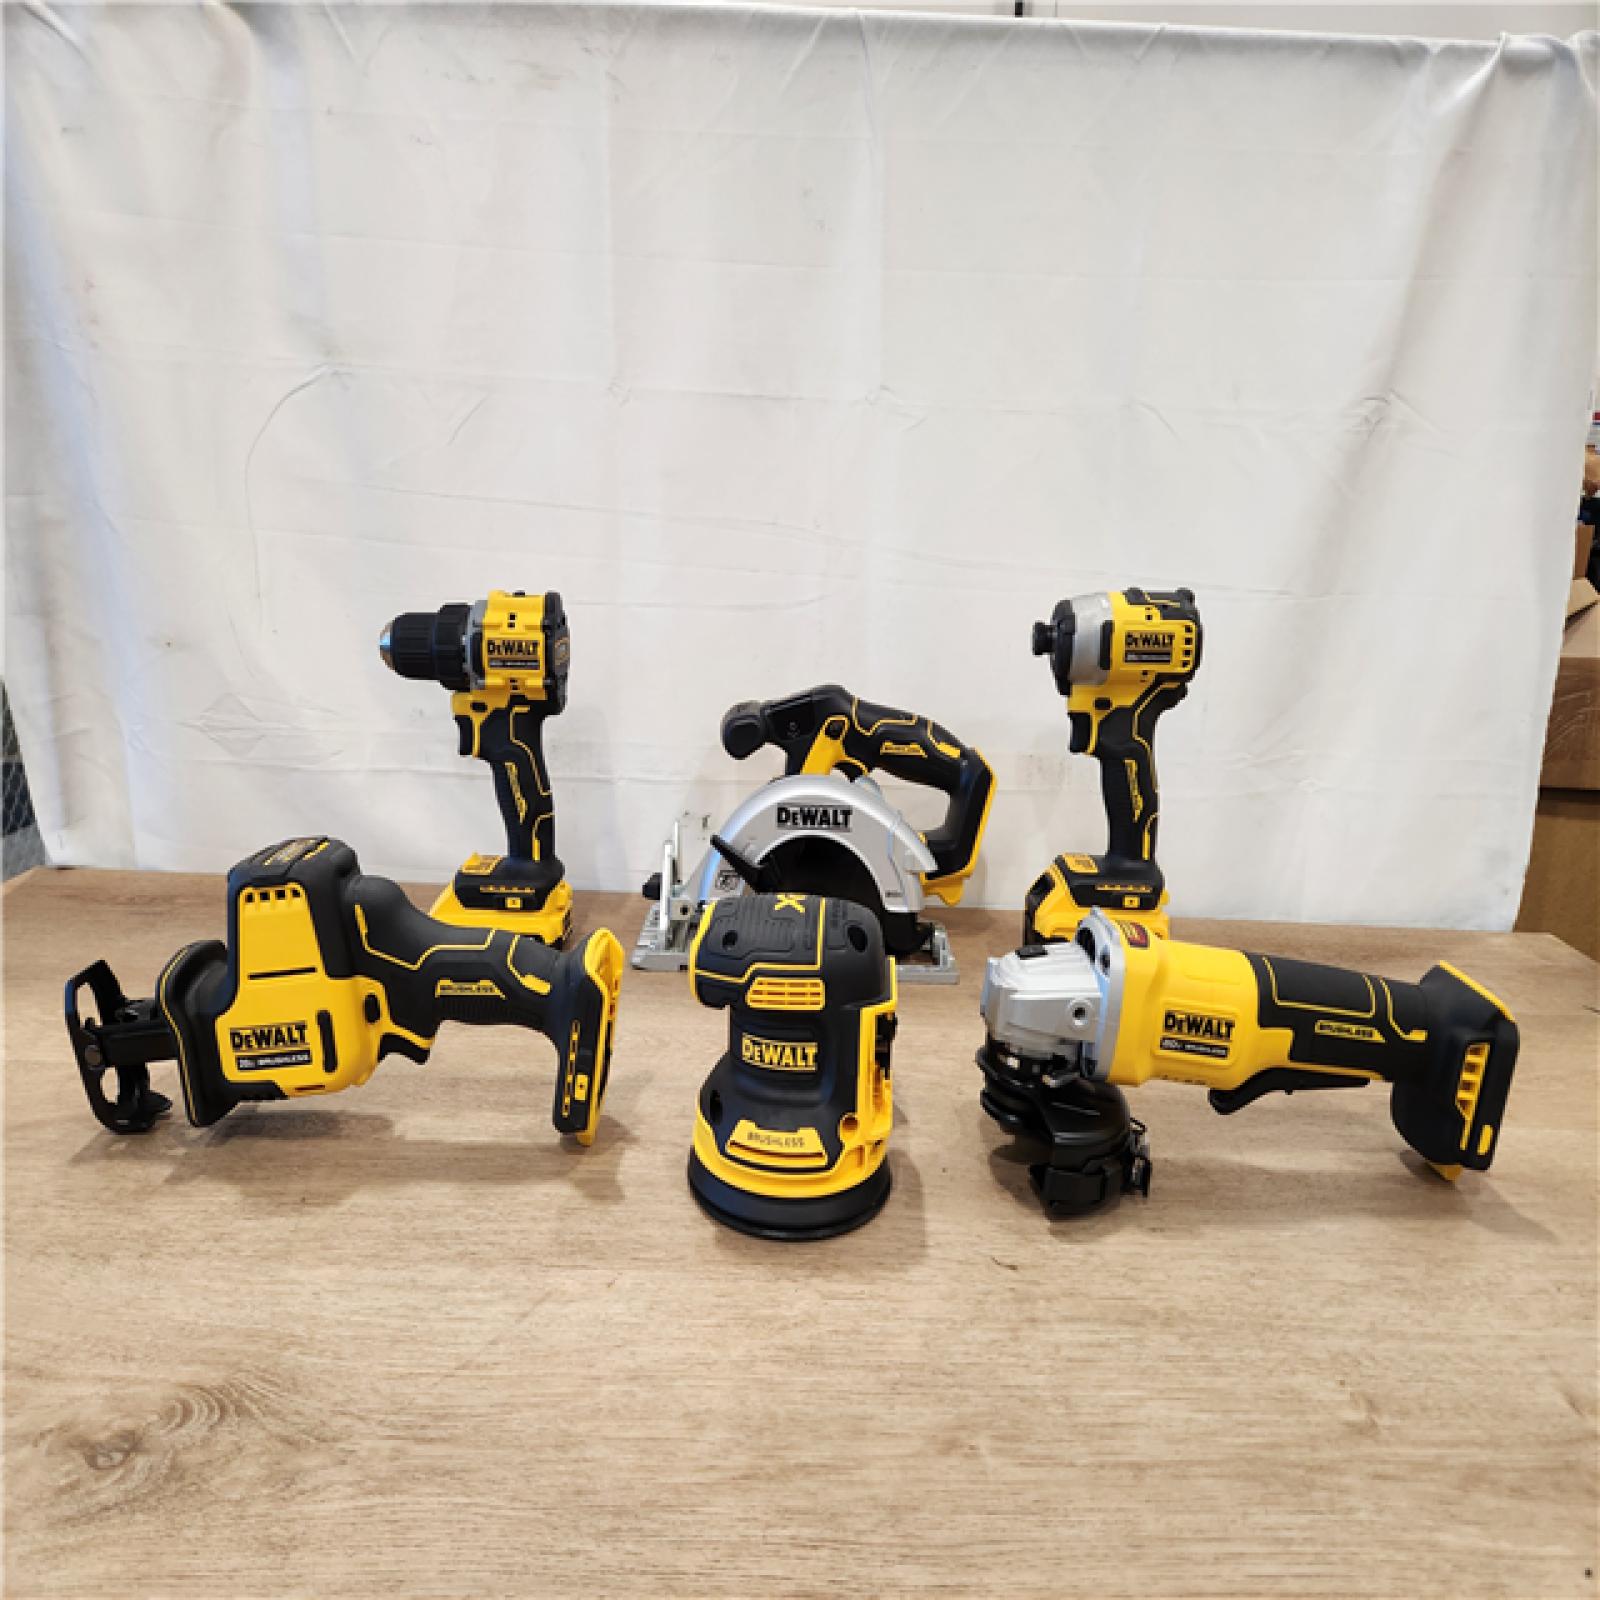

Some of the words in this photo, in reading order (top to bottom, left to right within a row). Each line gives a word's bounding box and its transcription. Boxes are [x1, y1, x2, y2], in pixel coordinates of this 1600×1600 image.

[486, 638, 539, 656] DEWALT
[1125, 632, 1175, 648] DEWALT
[776, 806, 852, 829] DEWALT
[231, 1022, 307, 1049] DEWALT
[1164, 1010, 1235, 1040] DEWALT
[742, 1033, 818, 1070] DEWALT
